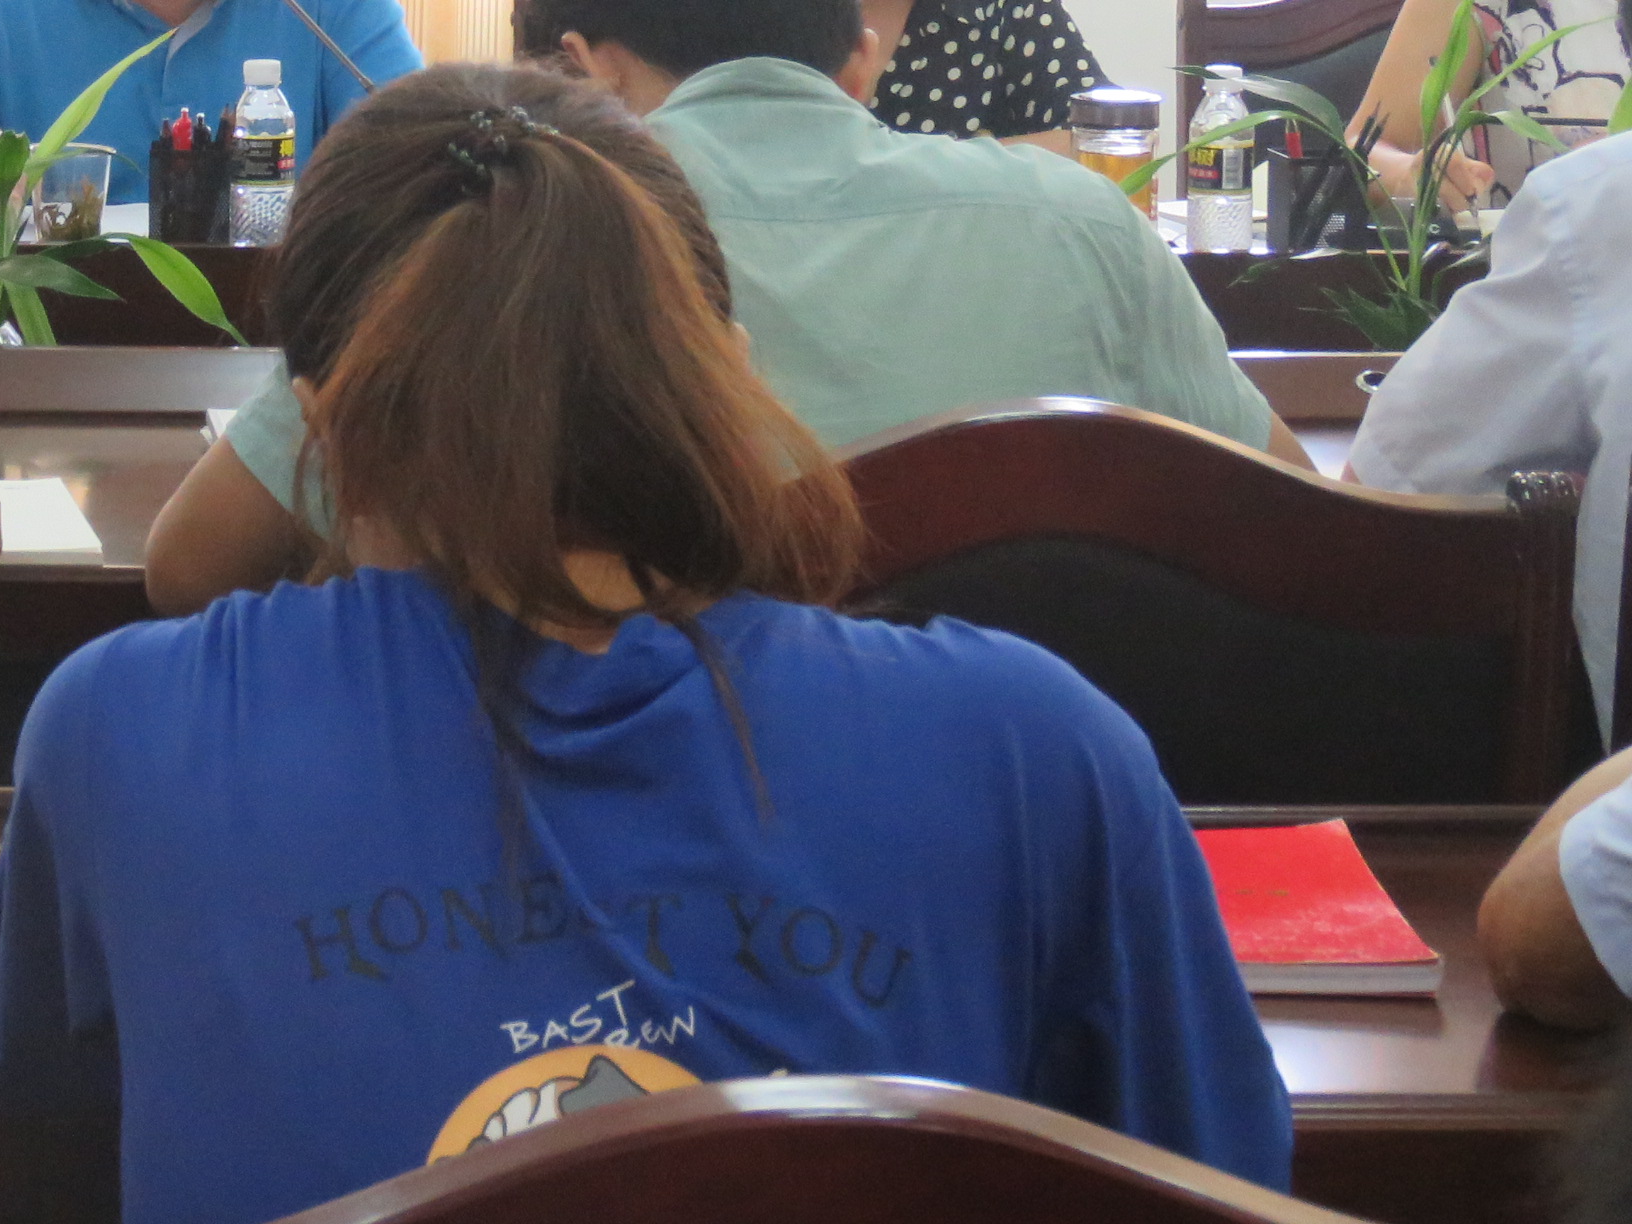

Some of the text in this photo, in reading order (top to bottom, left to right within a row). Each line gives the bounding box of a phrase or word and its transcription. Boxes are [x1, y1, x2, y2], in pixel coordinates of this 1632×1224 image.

[294, 872, 913, 1008] HONET YOU
[500, 979, 635, 1053] BAST
